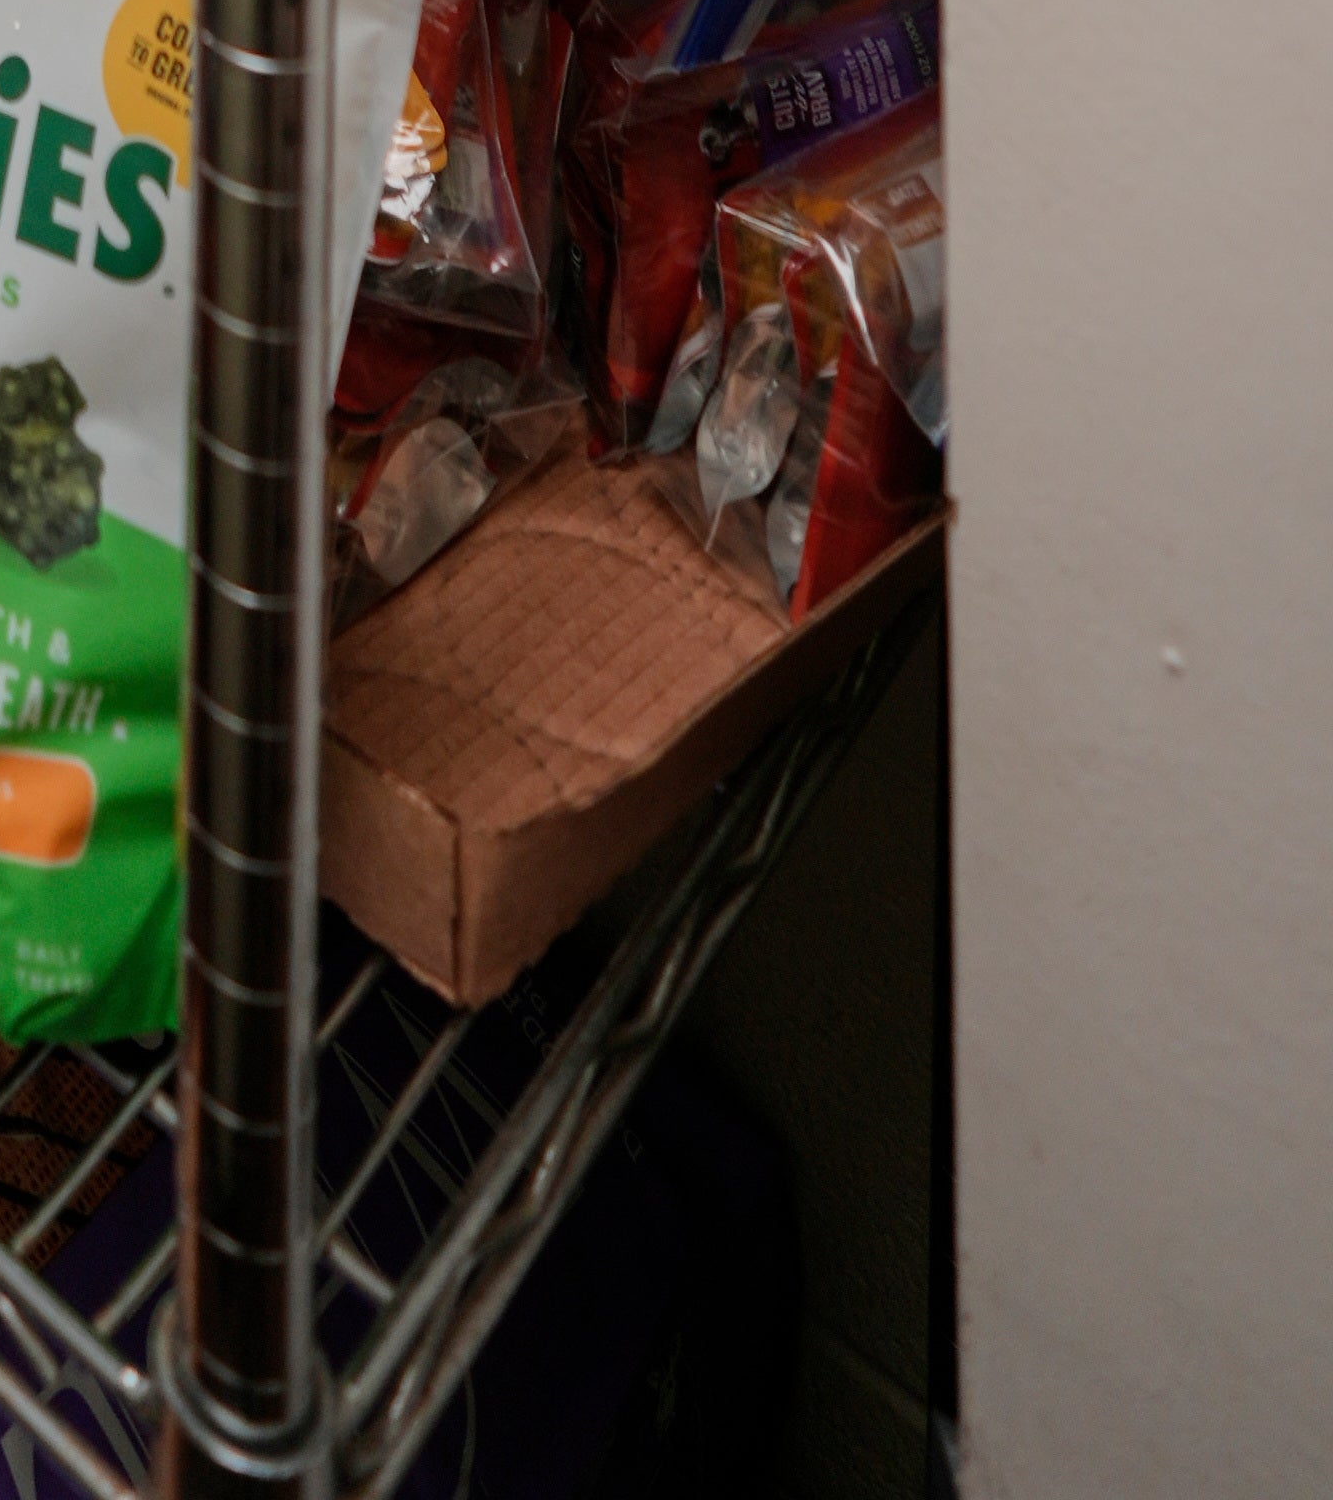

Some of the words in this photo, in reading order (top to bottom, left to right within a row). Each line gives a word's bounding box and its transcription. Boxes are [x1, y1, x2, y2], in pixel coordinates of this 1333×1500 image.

[766, 68, 797, 132] CUTS
[47, 629, 74, 664] &
[15, 939, 82, 965] DAILY
